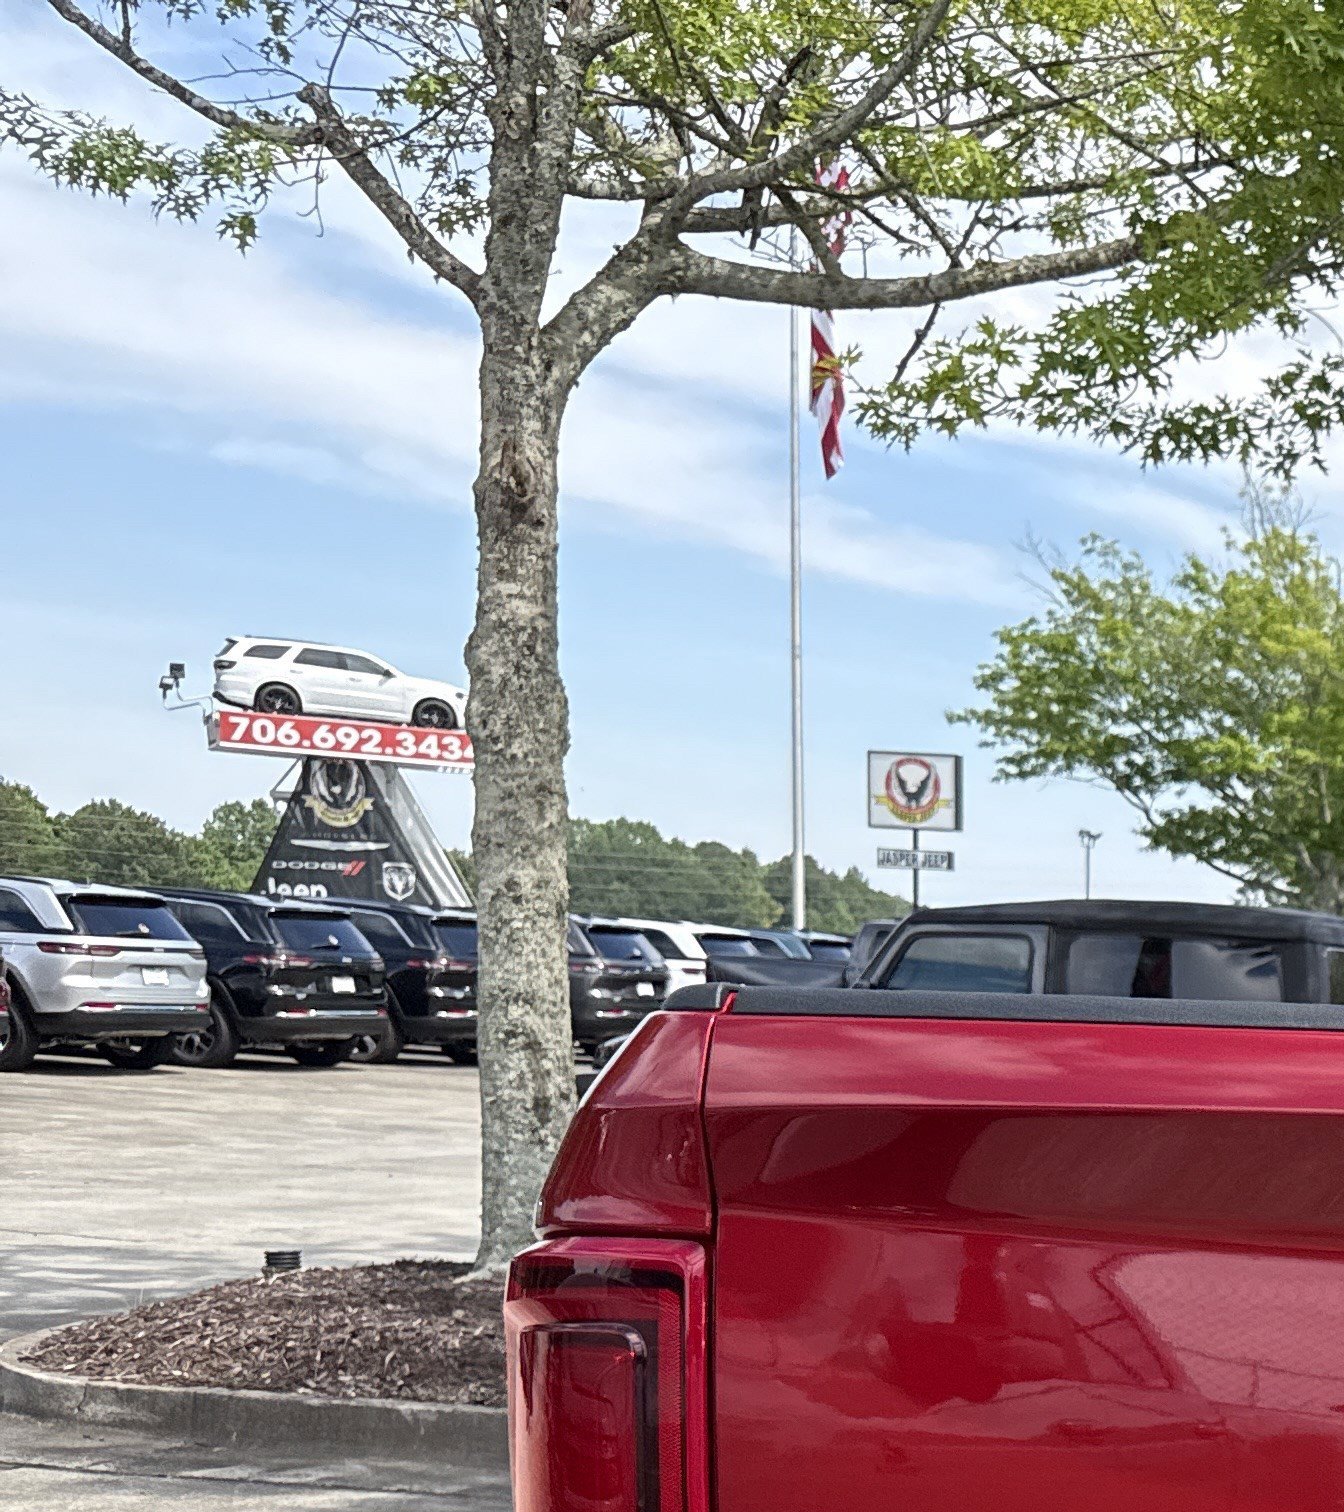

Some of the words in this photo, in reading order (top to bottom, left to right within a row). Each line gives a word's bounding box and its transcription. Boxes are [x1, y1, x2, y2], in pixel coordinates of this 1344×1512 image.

[272, 860, 352, 871] DODGE
[880, 851, 918, 867] JASPER
[922, 852, 948, 868] JEEP
